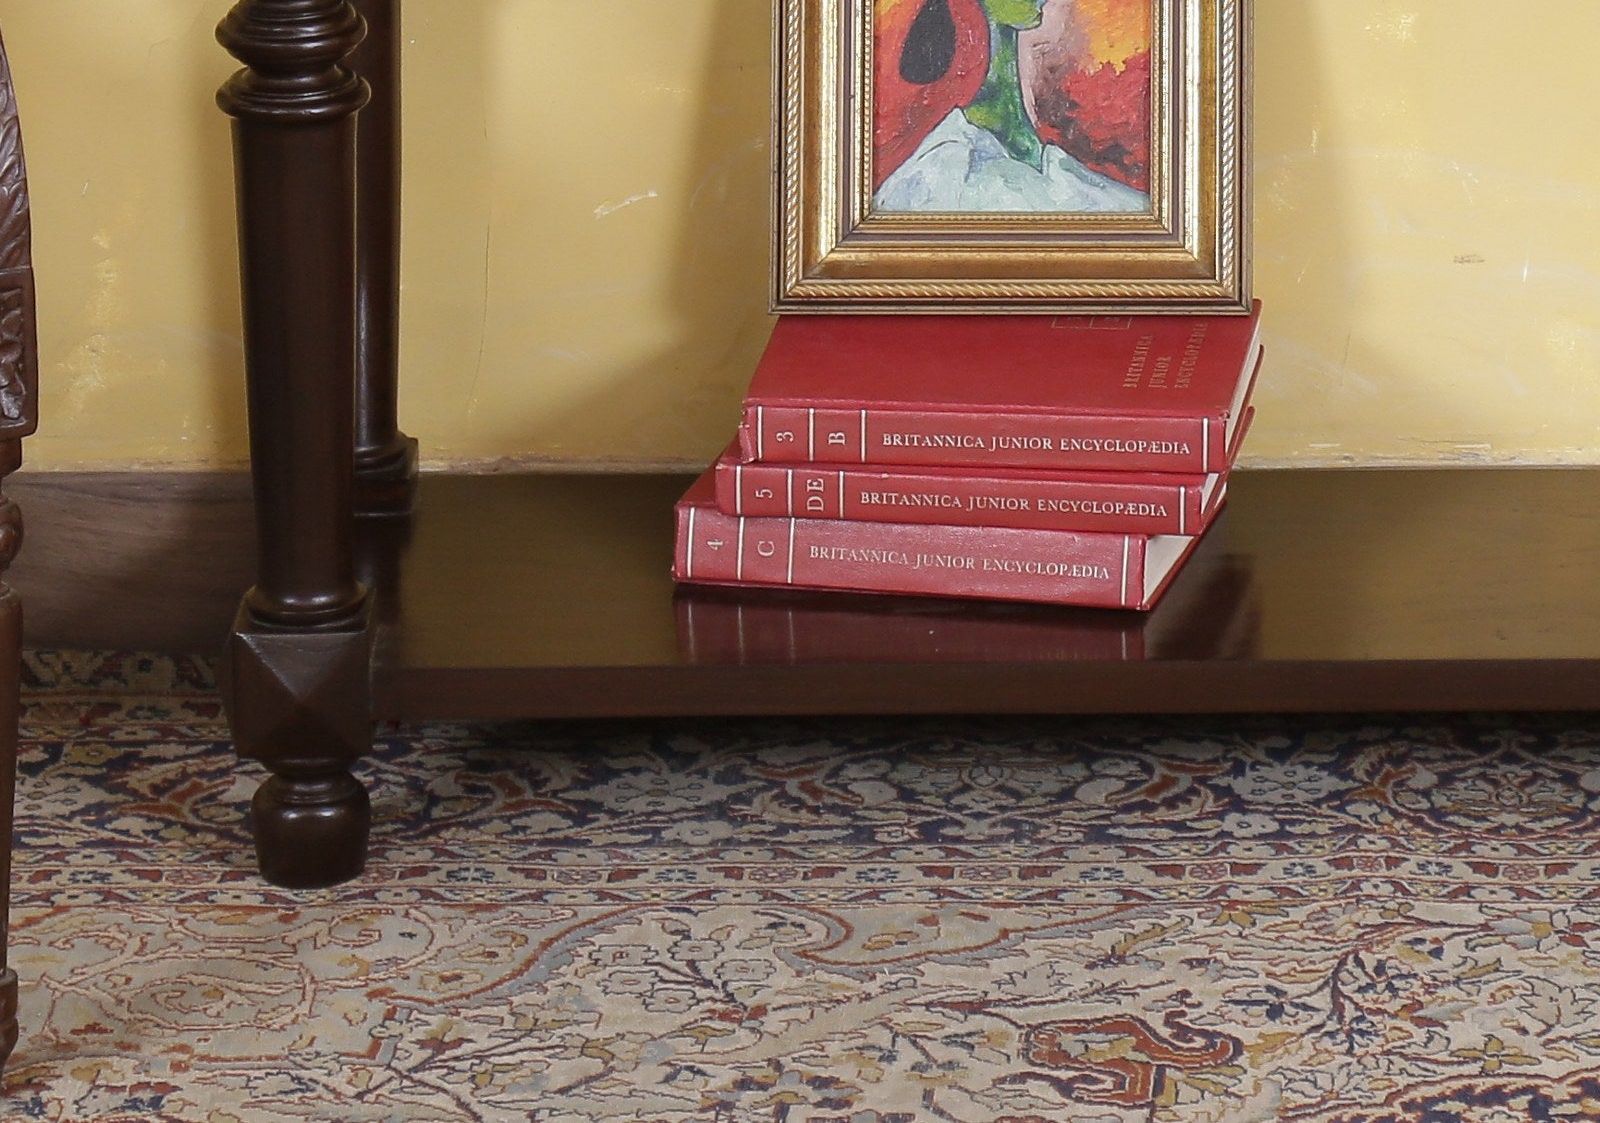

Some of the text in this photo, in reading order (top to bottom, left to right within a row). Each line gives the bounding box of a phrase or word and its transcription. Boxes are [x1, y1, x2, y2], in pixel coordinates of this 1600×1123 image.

[776, 430, 795, 443] 3
[828, 431, 846, 445] B
[882, 432, 985, 449] BRITANNICA
[988, 435, 1053, 452] JUNIOR
[755, 488, 773, 499] 5
[860, 491, 963, 508] BRITANNICA
[966, 495, 1031, 512] JUNIOR
[706, 538, 723, 551] 4
[757, 540, 776, 557] C
[809, 545, 909, 566] BRITANNICA
[912, 552, 975, 570] JUNIOR
